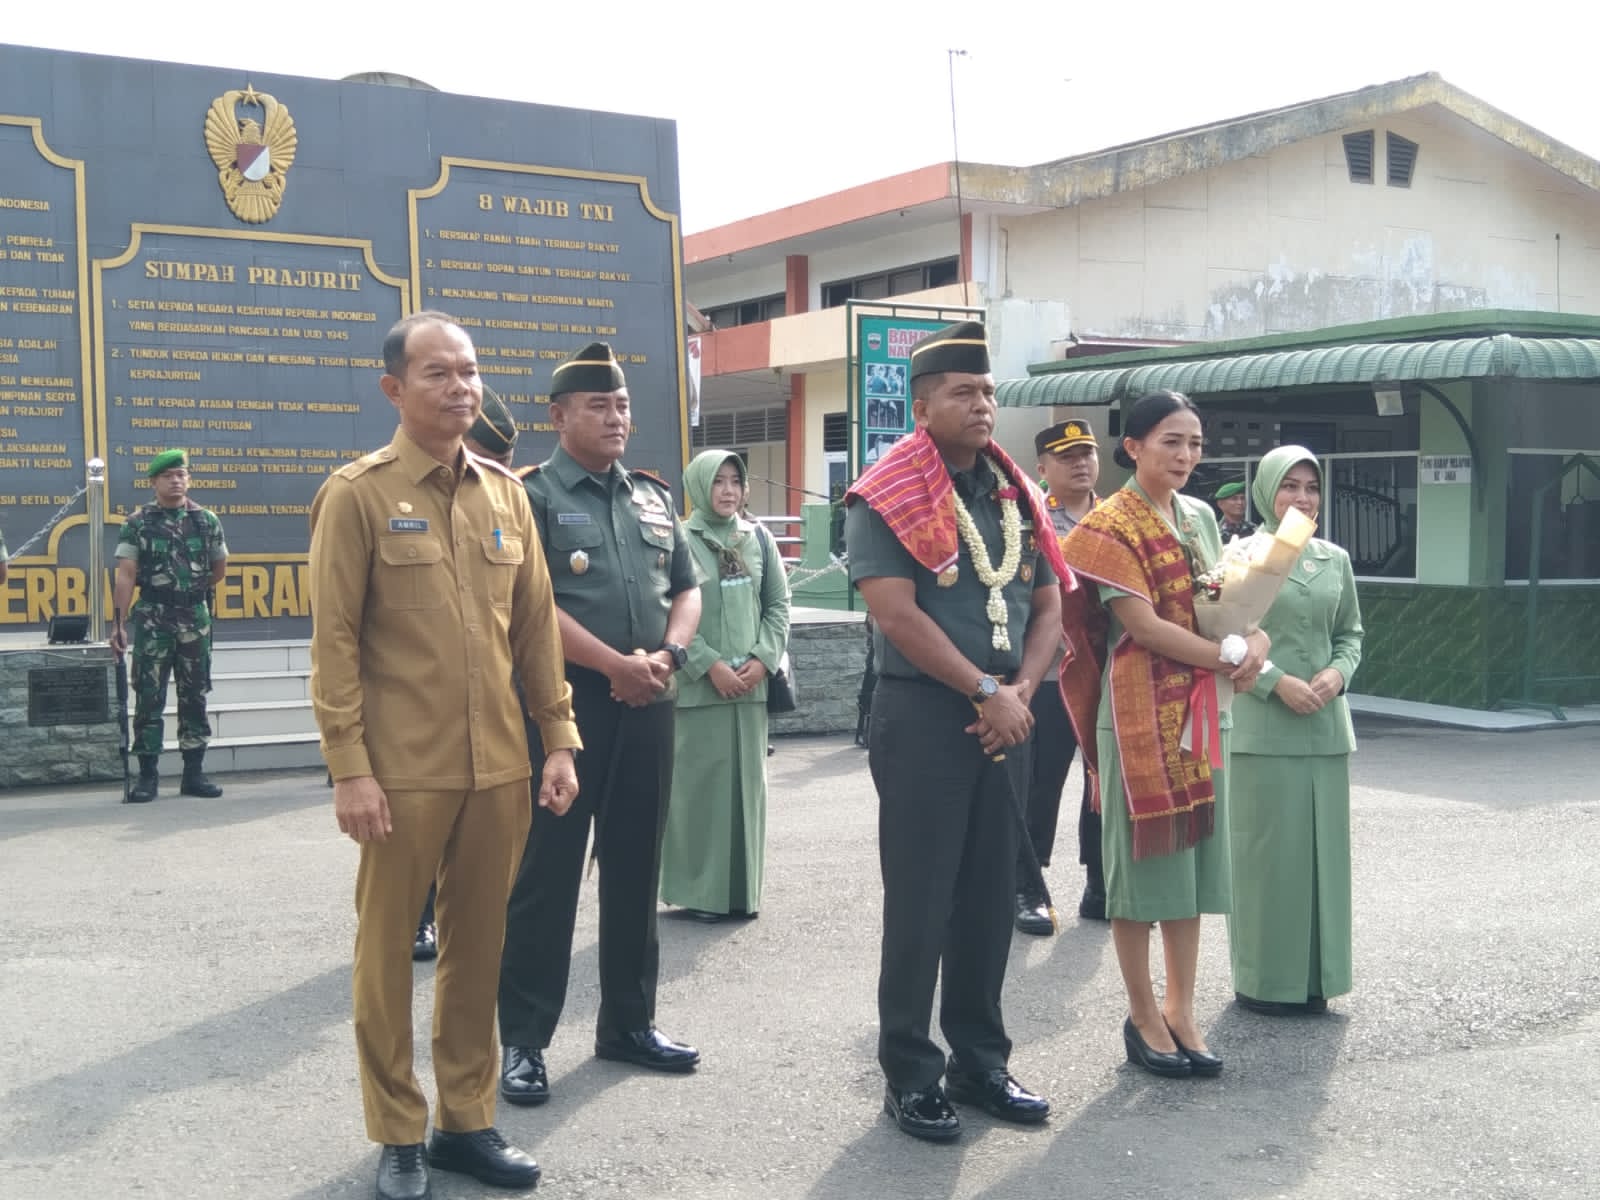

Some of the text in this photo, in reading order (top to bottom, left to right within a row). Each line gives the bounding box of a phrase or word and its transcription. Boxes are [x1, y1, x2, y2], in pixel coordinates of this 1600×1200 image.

[480, 193, 614, 222] 8 WAJIB TNI
[440, 230, 480, 241] BERSIKAP
[484, 233, 511, 245] RAMAH
[545, 239, 585, 250] TERHADAP
[589, 242, 619, 253] RAKYAT
[10, 250, 31, 261] DAN
[36, 252, 64, 263] TIDAK
[145, 260, 361, 291] SUMPAH PRAJURIT
[441, 259, 483, 271] BERSIKAP
[487, 262, 514, 274] SOPAN
[518, 265, 550, 276] SANTUN
[556, 268, 597, 279] TERHADAP
[600, 271, 631, 282] RAKYAT
[42, 288, 75, 300] TUHAN
[532, 294, 583, 305] KEHORMATAN
[13, 303, 72, 314] KEBENARAN
[128, 299, 155, 310] SETIA
[158, 300, 193, 312] KEPADA
[197, 303, 233, 314] NEGARA
[237, 305, 282, 316] KESATUAN
[285, 307, 328, 320] REPUBLIK
[332, 310, 376, 321] INDONESIA
[129, 321, 348, 341] YANG BERDASARKAN PANCASILA DAN UUD 1945
[18, 339, 56, 350] ADALAH
[130, 349, 168, 360] TUNDUK
[173, 350, 208, 361] KEPADA
[212, 353, 243, 363] HUKUM
[247, 354, 264, 364] DAN
[130, 369, 200, 381] KEPRAJURITAN
[46, 392, 76, 402] SERTA
[132, 396, 153, 407] TAAT
[159, 398, 195, 409] KEPADA
[200, 399, 233, 410] ATASAN
[237, 401, 273, 411] DENGAN
[278, 403, 303, 413] TIDAK
[14, 406, 64, 417] PRAJURIT
[132, 418, 178, 430] PERINTAH
[208, 421, 251, 432] PUTUSAN
[207, 447, 243, 458] SEGALA
[301, 448, 337, 459] DENGAN
[34, 458, 72, 469] KEPADA
[223, 463, 258, 474] KEPADA
[263, 463, 303, 474] TENTARA
[307, 464, 325, 474] DAN
[188, 479, 237, 490] NDONESIA
[21, 495, 49, 505] SETIA
[230, 504, 267, 515] RAHASIA
